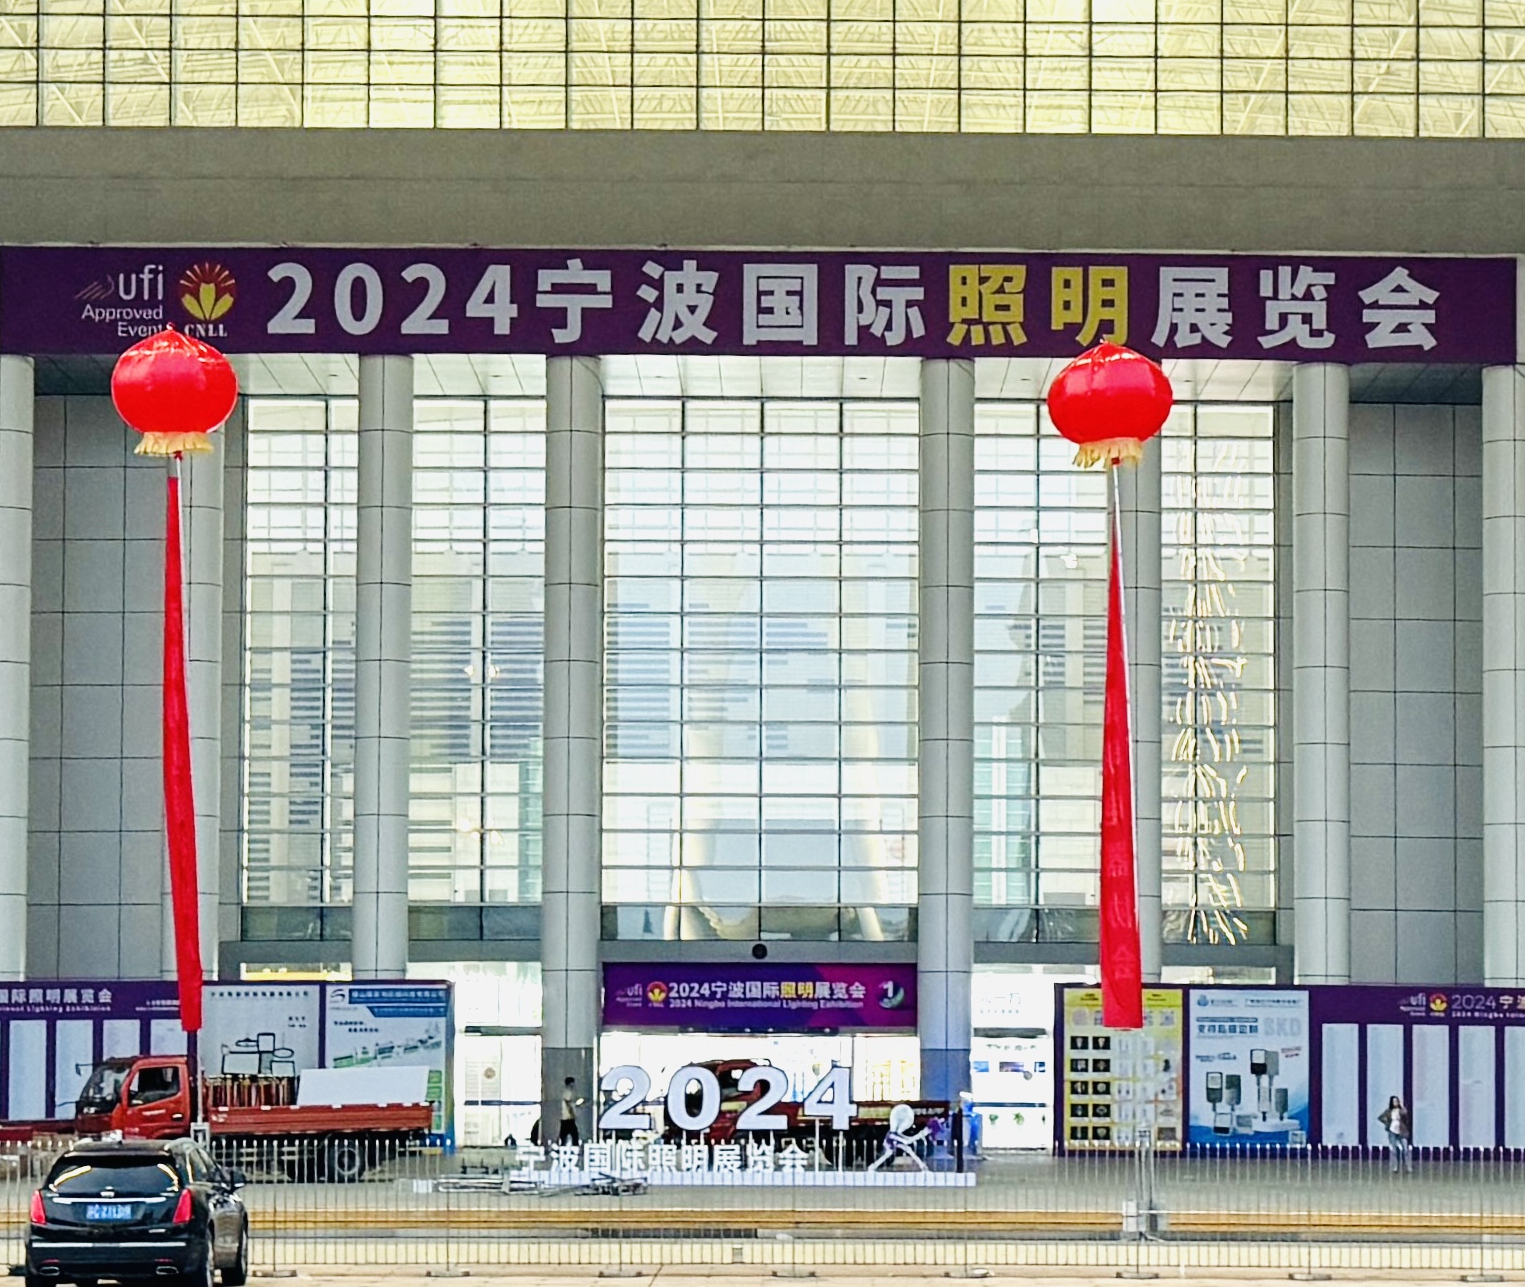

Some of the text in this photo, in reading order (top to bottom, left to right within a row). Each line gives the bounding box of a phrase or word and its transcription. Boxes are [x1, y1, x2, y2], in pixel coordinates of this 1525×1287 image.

[119, 265, 164, 300] ufi
[81, 304, 163, 322] Approved
[266, 258, 1441, 351] 2024宁波国际照明展览会
[668, 981, 866, 999] 2024宁波国际照明展览会
[598, 1064, 858, 1131] 2024
